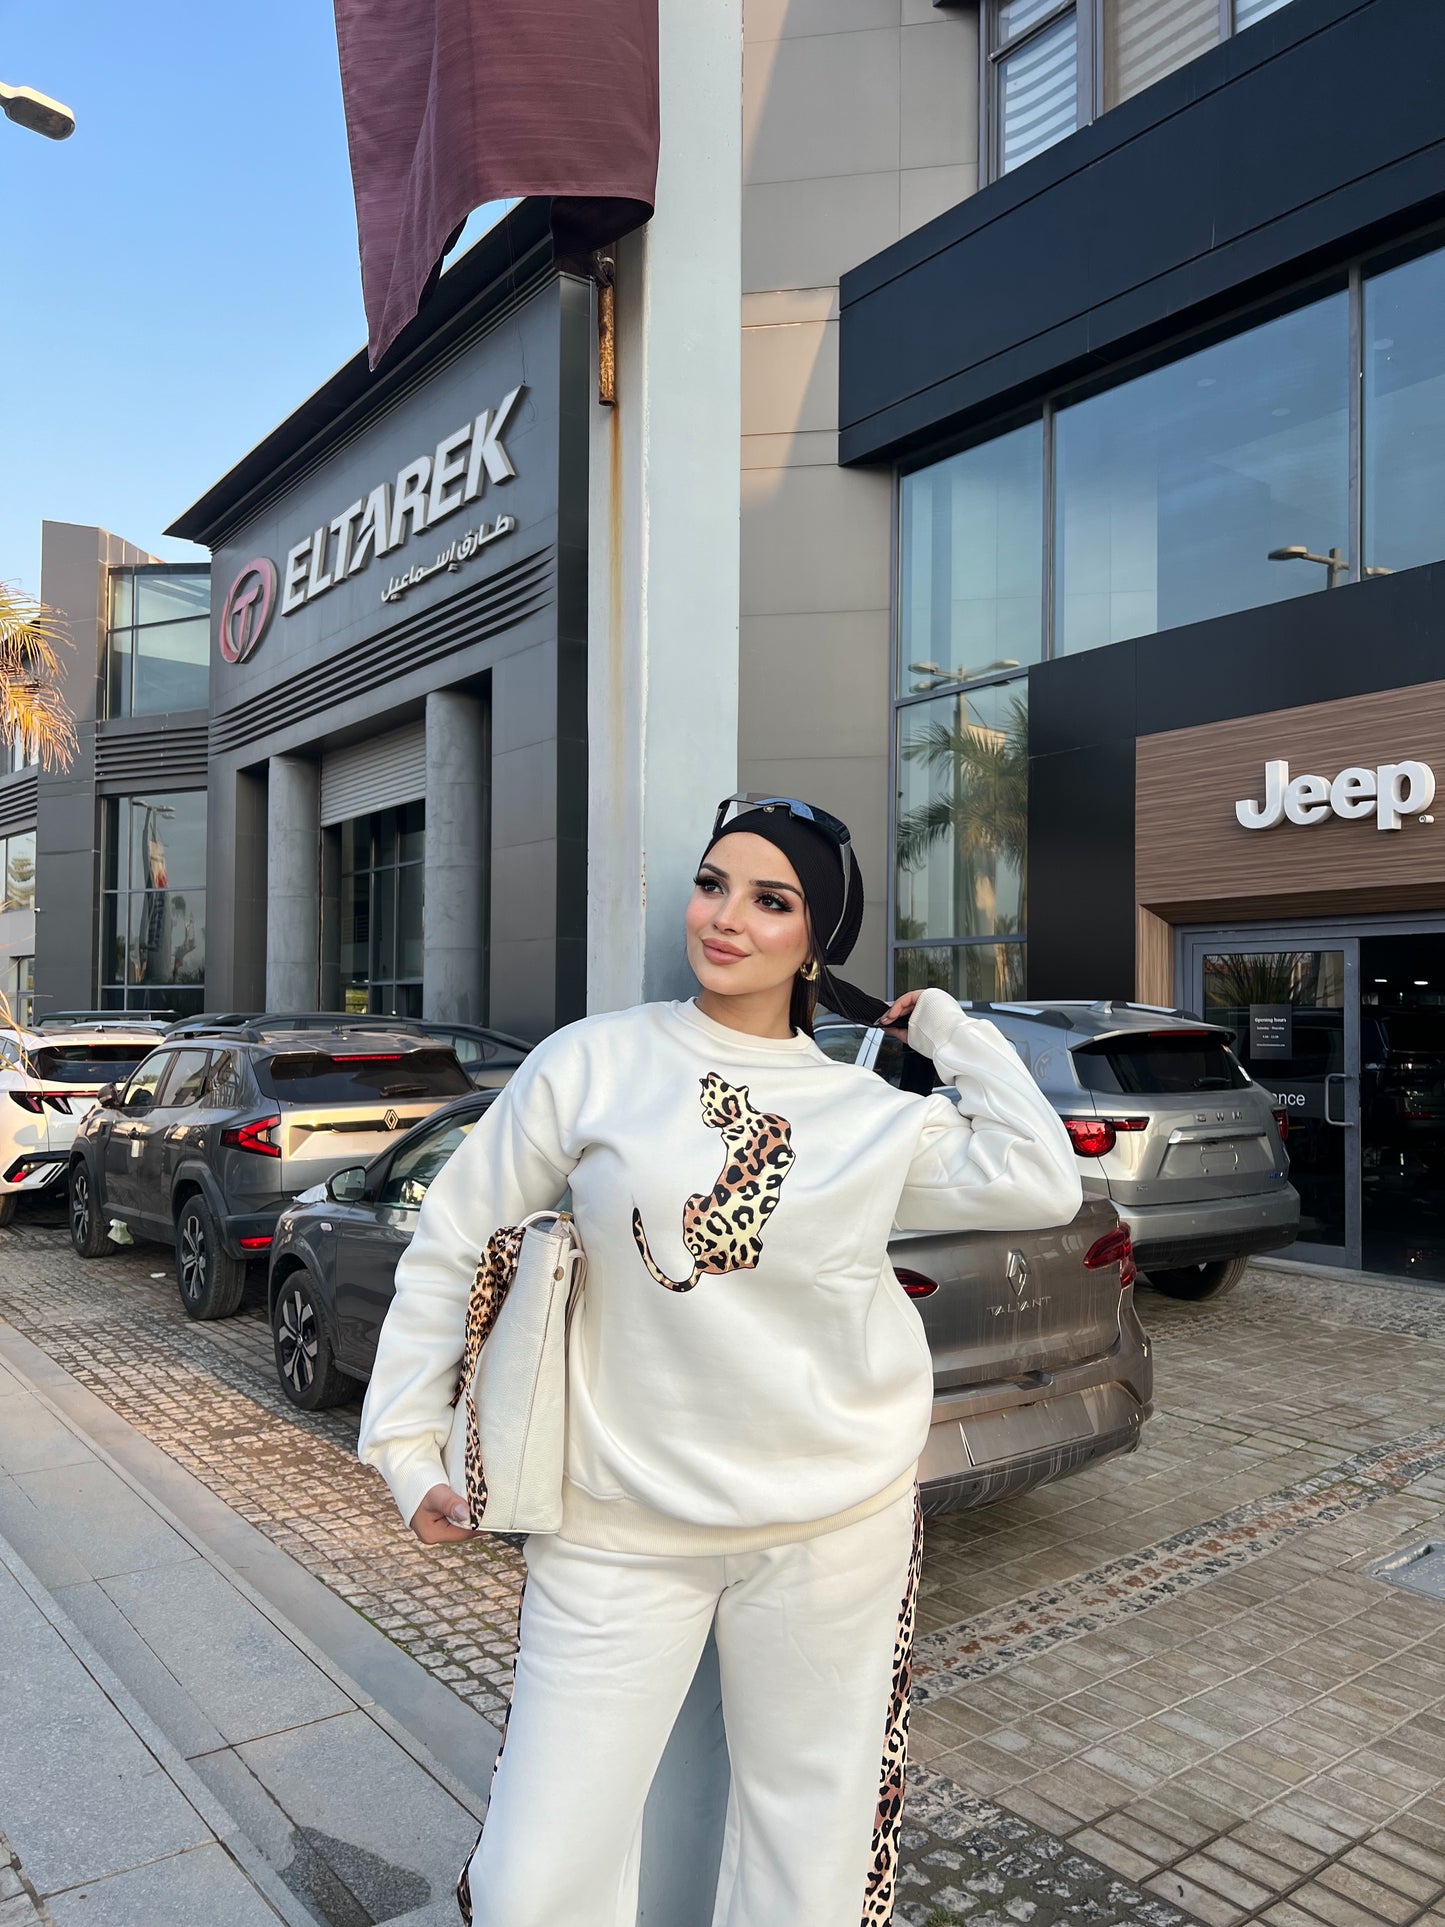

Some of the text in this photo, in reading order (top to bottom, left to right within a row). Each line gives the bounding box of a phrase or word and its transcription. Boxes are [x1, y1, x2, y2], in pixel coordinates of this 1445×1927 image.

[280, 384, 526, 617] ELTAREK
[457, 513, 516, 561] طارق
[1235, 759, 1436, 830] Jeep
[1195, 1111, 1243, 1123] GWM
[986, 1295, 1052, 1316] TALIANT
